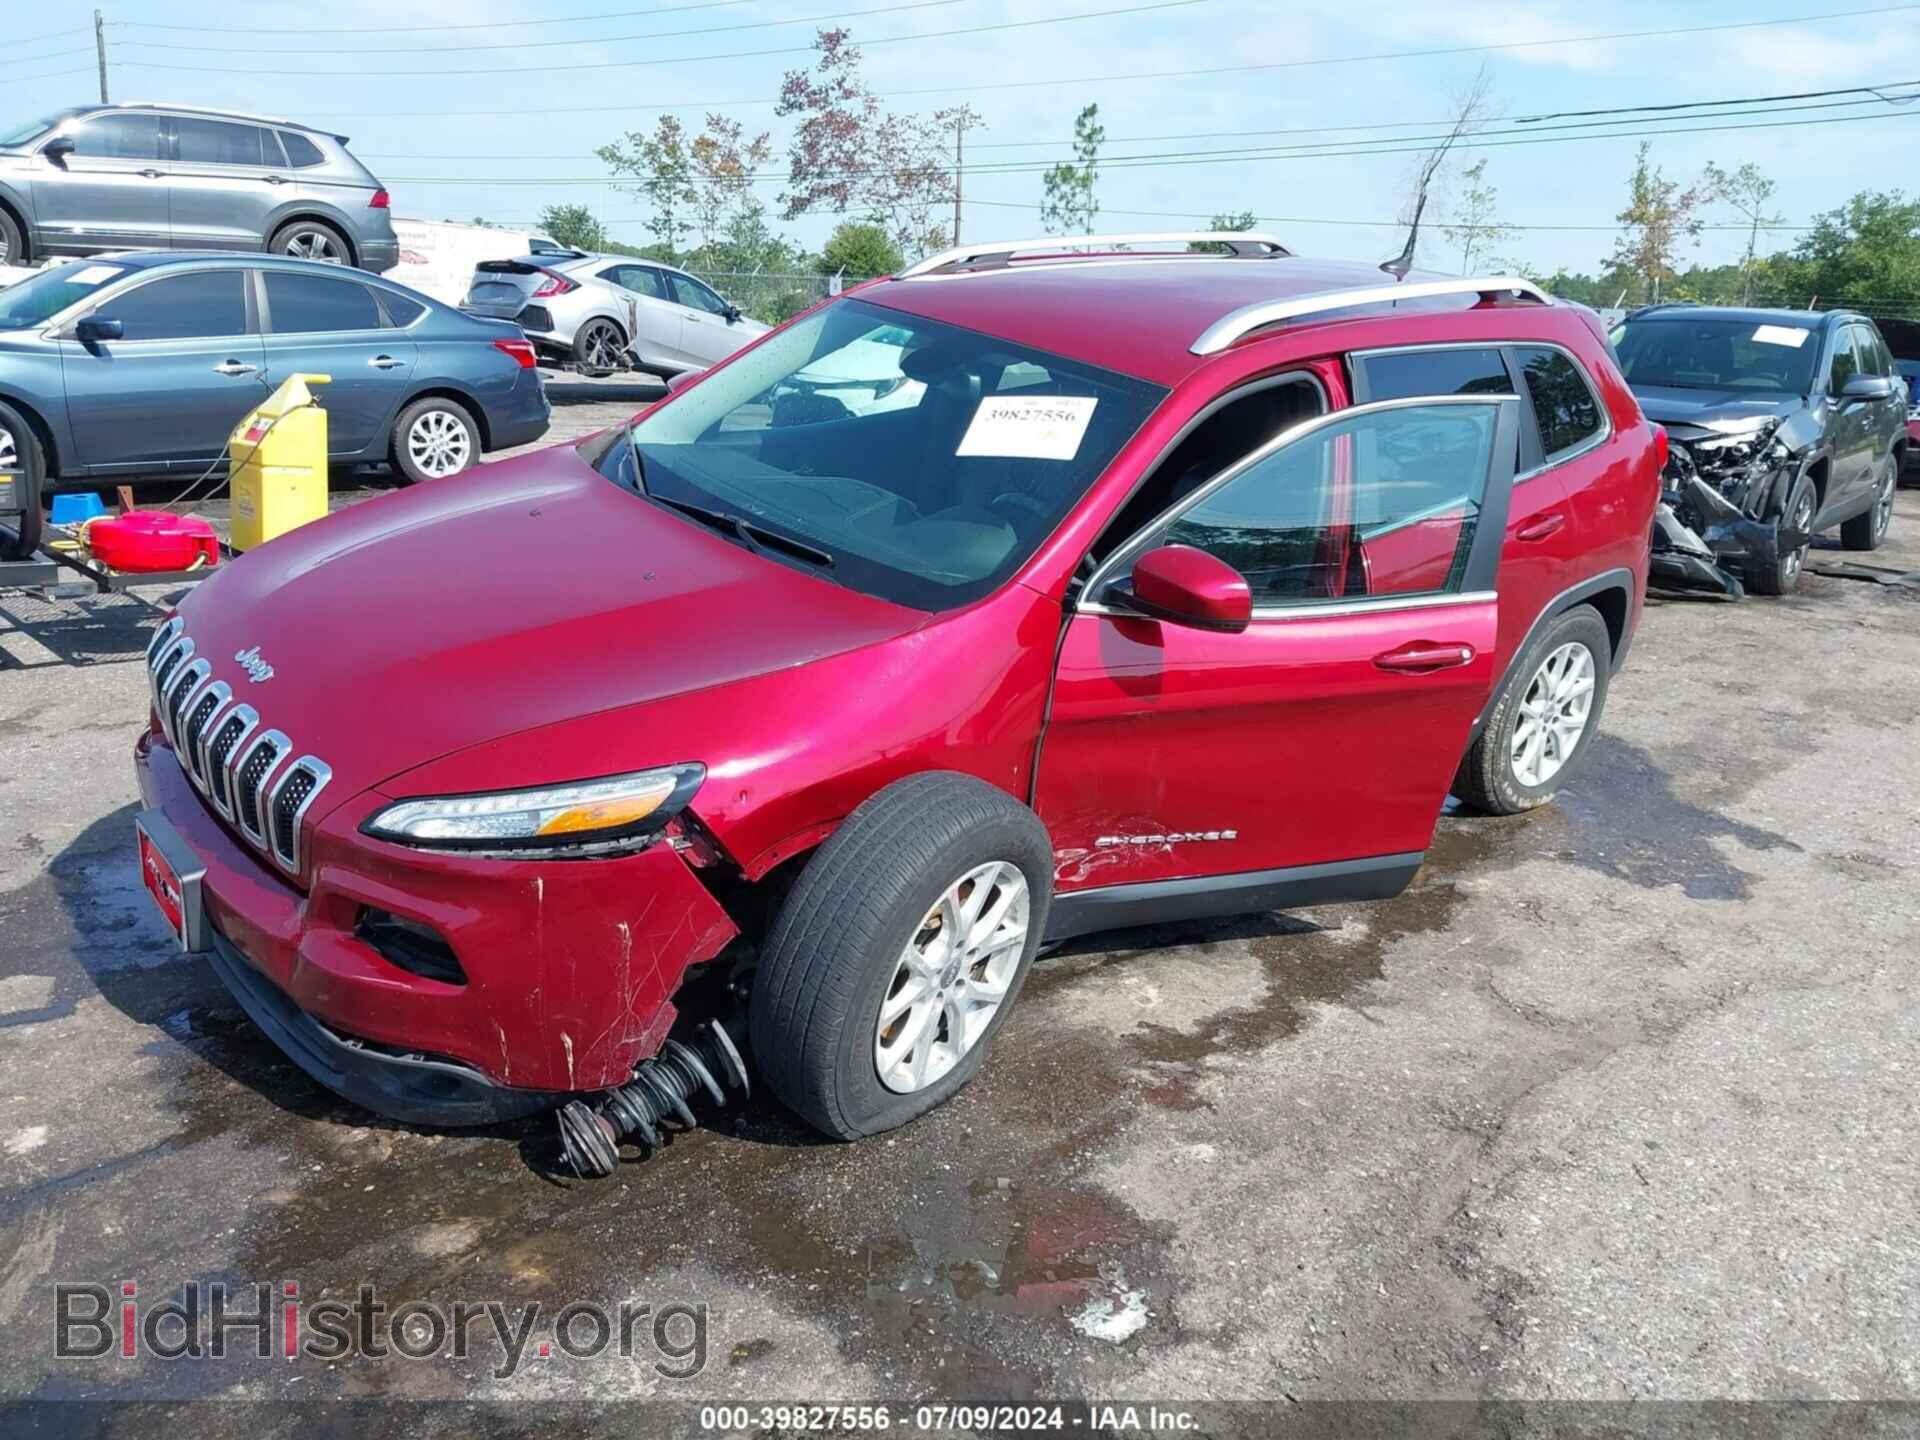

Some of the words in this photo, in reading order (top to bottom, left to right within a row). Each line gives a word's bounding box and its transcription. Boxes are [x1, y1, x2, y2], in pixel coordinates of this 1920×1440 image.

[984, 408, 1077, 422] 39827556
[234, 645, 275, 684] Jeep
[1094, 829, 1238, 848] CHEROKEE
